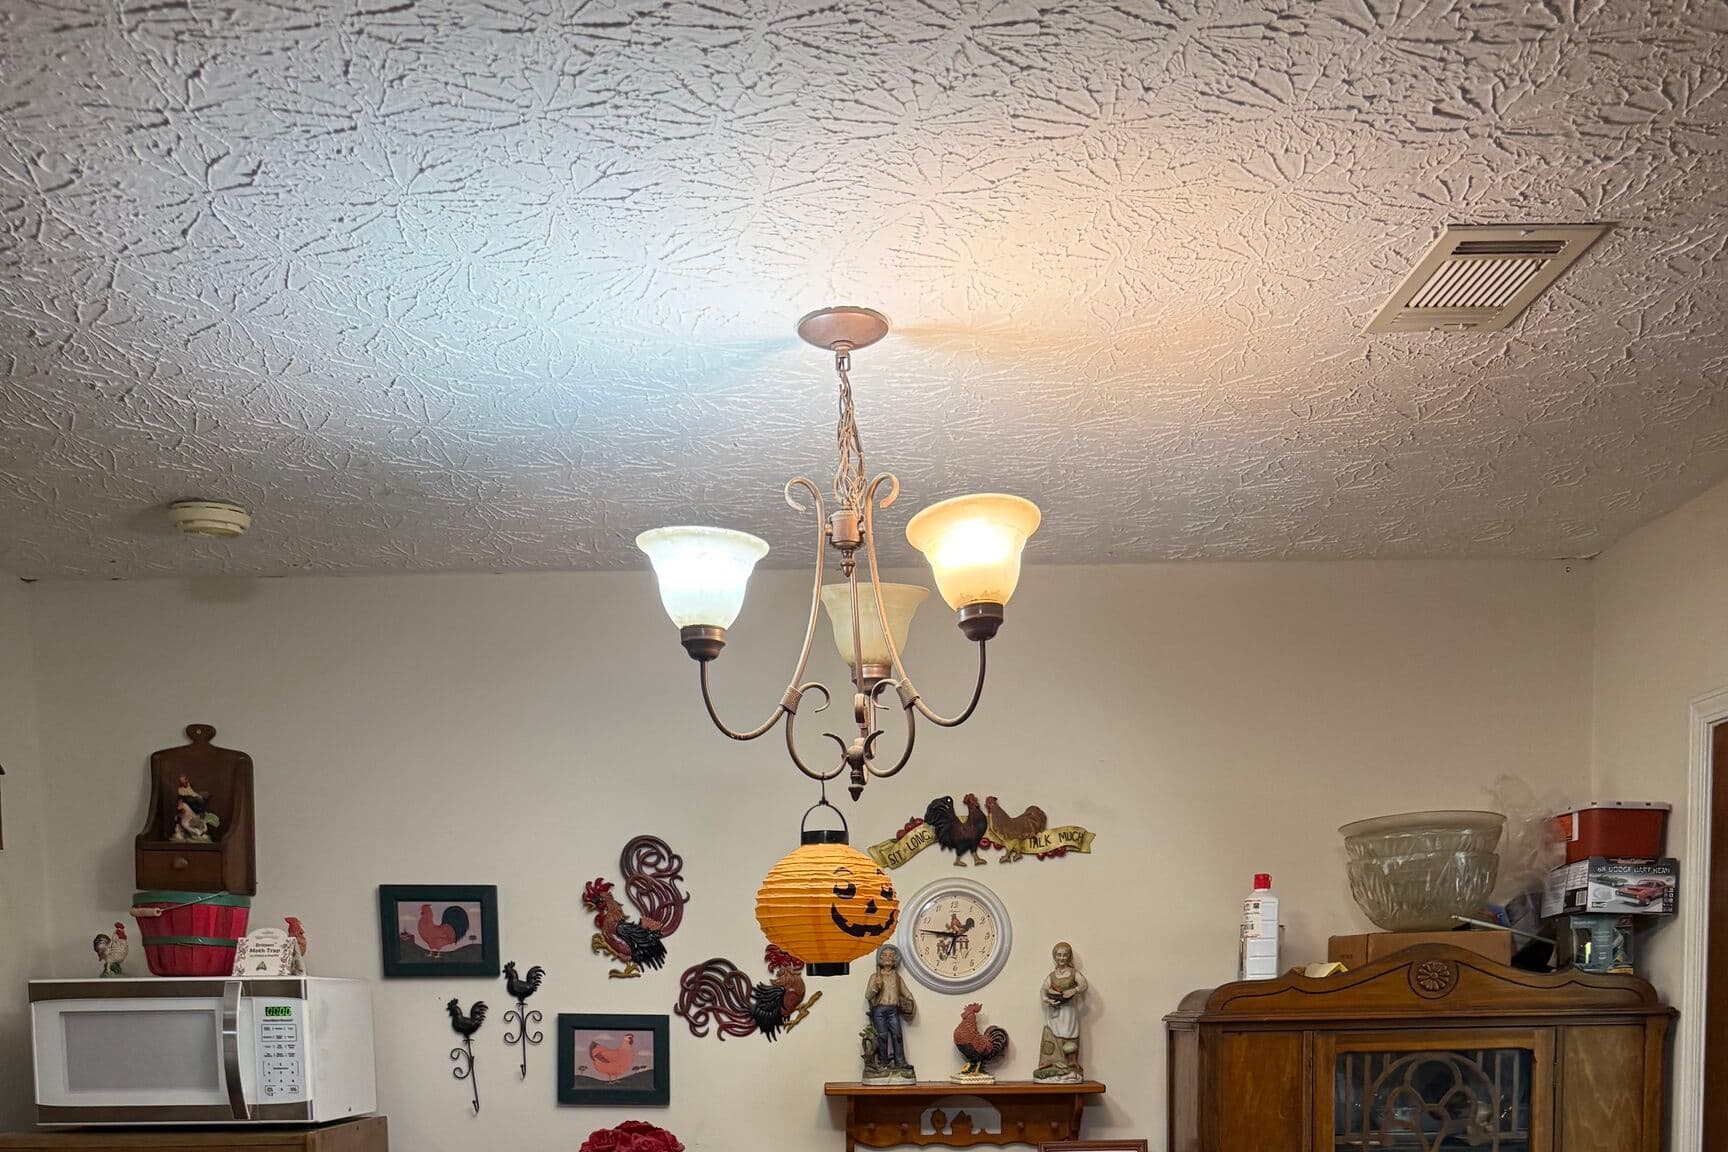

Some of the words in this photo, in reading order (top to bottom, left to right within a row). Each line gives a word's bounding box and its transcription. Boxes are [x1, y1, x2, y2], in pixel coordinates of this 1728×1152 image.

[888, 849, 903, 865] SIT
[906, 830, 931, 851] LONG
[1028, 833, 1051, 849] TALK
[1058, 830, 1085, 844] MUCH
